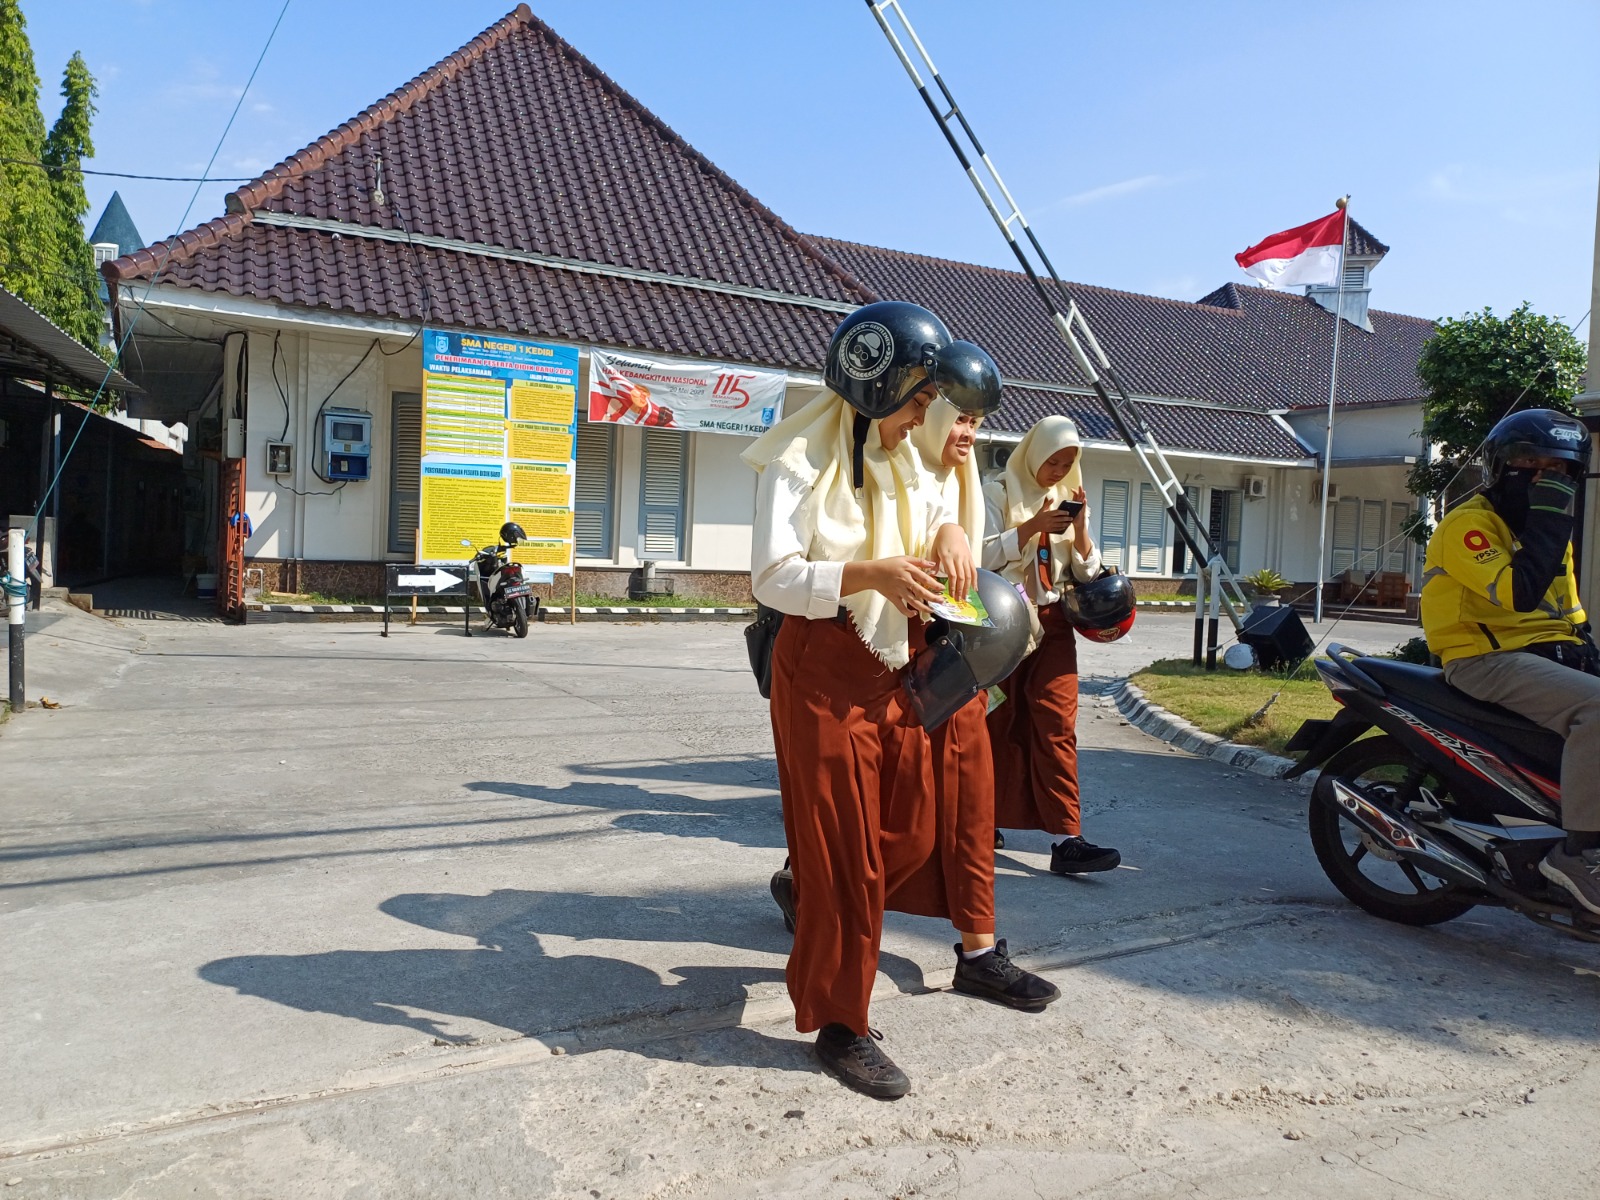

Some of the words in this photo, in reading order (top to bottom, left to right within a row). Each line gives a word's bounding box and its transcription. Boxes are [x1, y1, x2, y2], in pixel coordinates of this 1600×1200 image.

[461, 338, 481, 348] SMA
[483, 341, 516, 352] NEGERI
[525, 347, 554, 356] KEDIRI
[429, 364, 450, 373] WAKTU
[451, 366, 492, 376] PELAKSANAAN
[435, 354, 482, 366] PENERIMAAN
[483, 359, 514, 369] PESERTA
[515, 363, 534, 371] DIDIK
[536, 365, 555, 374] BARU
[555, 368, 574, 376] 2023
[606, 355, 654, 372] Selamat
[619, 370, 671, 383] KEBANGKITAN
[672, 377, 708, 387] NASIONAL
[712, 373, 757, 409] 115
[699, 420, 715, 428] SMA
[716, 421, 743, 431] NEGERI
[749, 425, 770, 433] KEDIR
